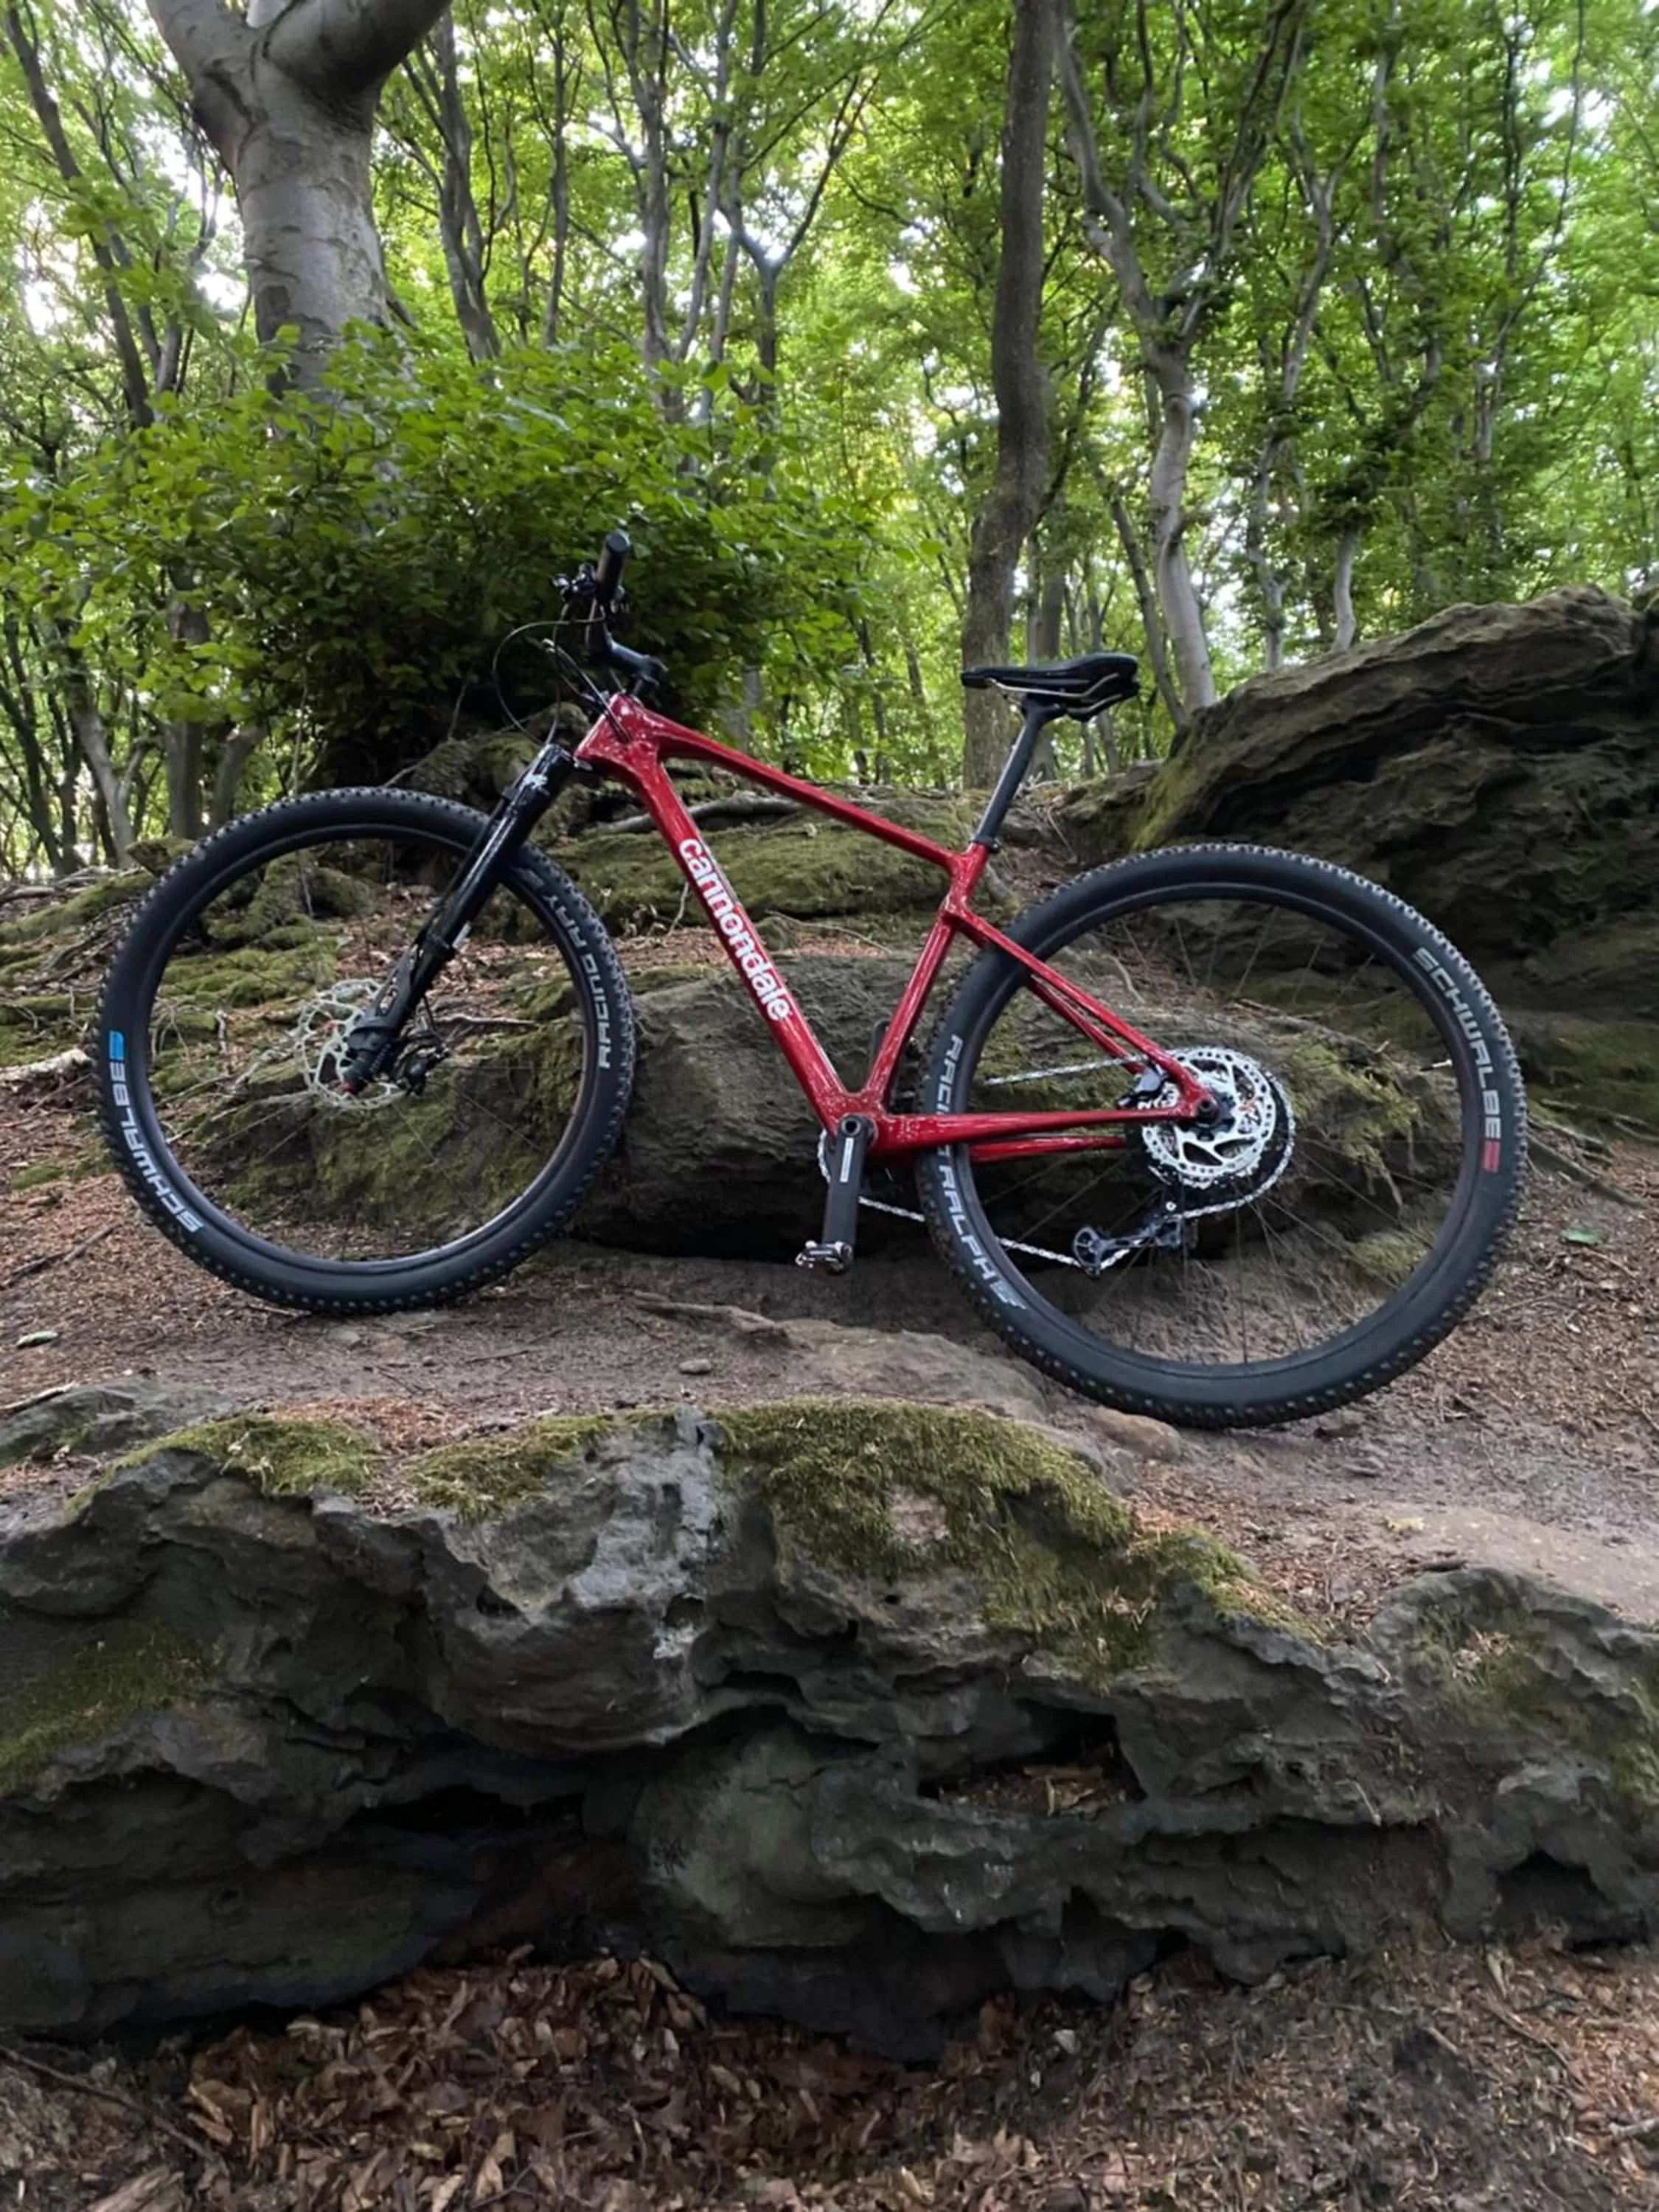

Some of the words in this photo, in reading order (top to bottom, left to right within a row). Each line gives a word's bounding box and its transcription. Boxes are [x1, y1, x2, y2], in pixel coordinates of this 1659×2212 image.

[543, 895, 587, 948] RAY
[678, 838, 792, 1021] cannondale
[582, 953, 611, 1069] RACING
[1413, 947, 1501, 1139] SCHWALBE
[110, 1062, 204, 1233] SCHWALBE
[936, 1034, 964, 1158] RACI
[939, 1165, 997, 1281] RALPH
